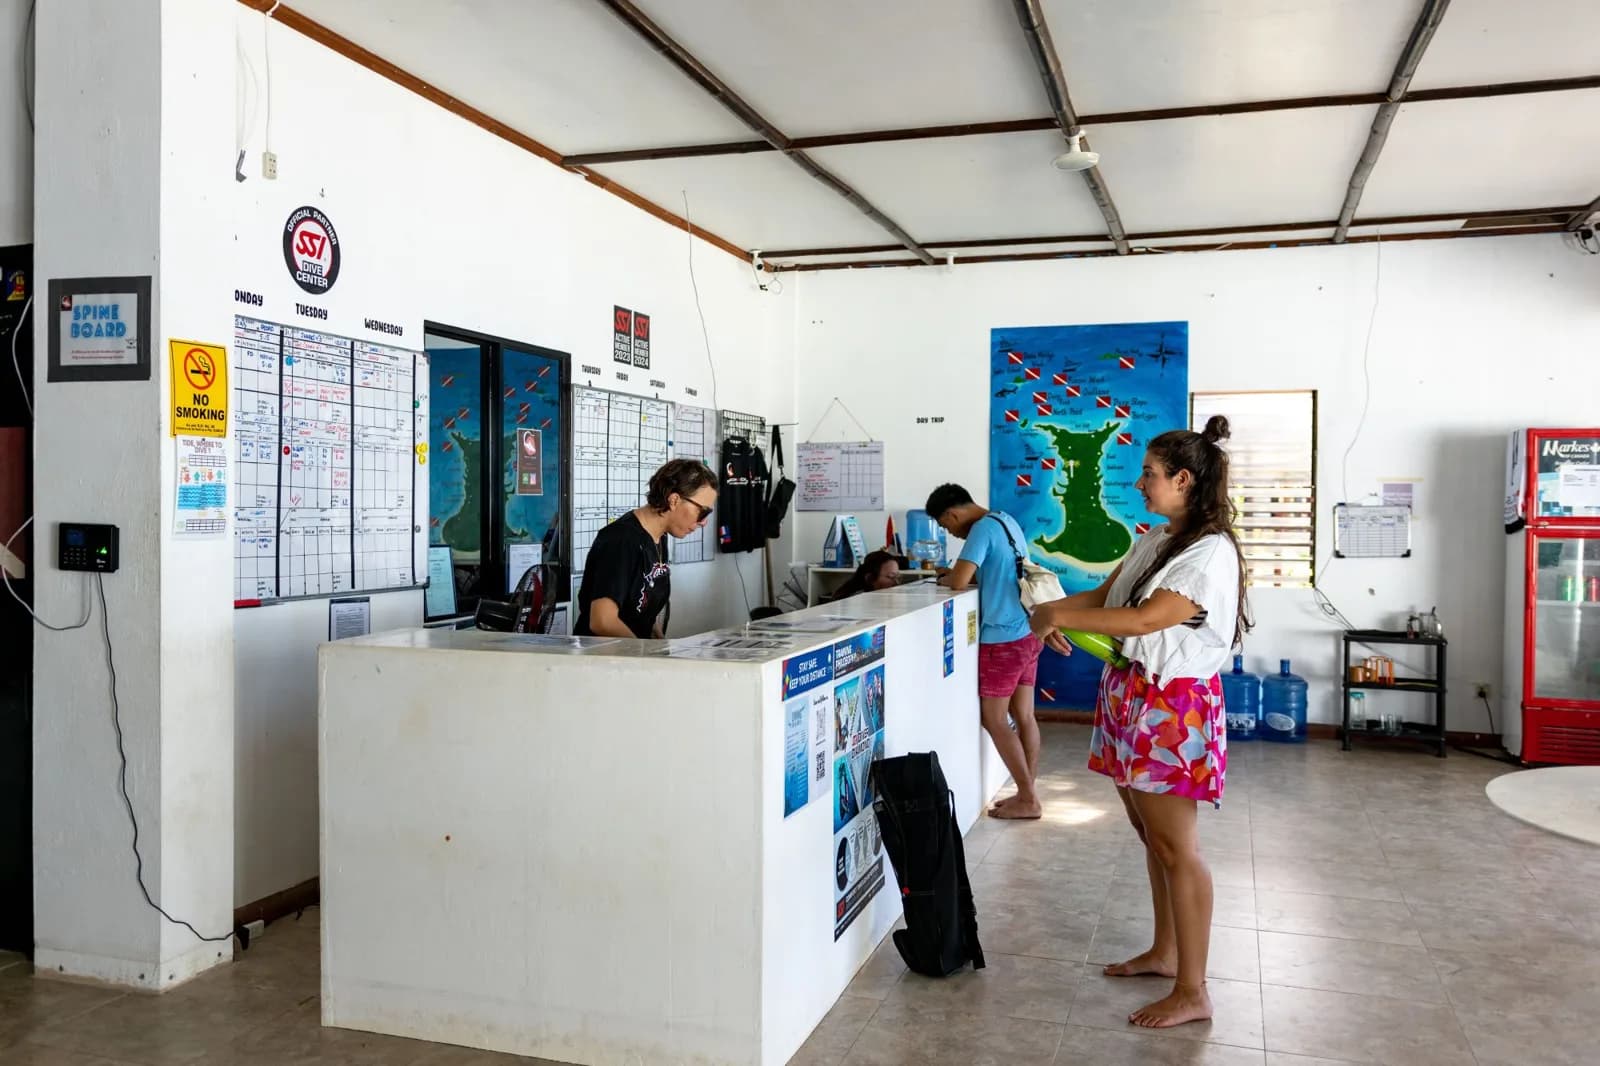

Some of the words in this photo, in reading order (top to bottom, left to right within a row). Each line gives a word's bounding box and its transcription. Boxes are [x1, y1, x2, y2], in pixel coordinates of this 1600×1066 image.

[287, 209, 311, 232] OFFICIAL
[313, 211, 337, 246] PARTNER
[295, 230, 326, 260] SSI
[302, 261, 323, 276] DIVE
[296, 270, 328, 289] CENTER
[234, 289, 263, 307] ONDAY
[73, 304, 120, 320] SPINE
[295, 303, 328, 320] TUESDAY
[364, 318, 403, 336] WEDNESDAY
[614, 310, 631, 333] SSI
[634, 316, 649, 339] SSI
[71, 322, 126, 338] BOARD
[614, 333, 631, 344] ACTIVE
[634, 339, 649, 350] ACTIVE
[614, 350, 631, 362] 2023
[634, 356, 649, 367] 2024
[193, 394, 209, 406] NO
[176, 407, 225, 421] SMOKING
[1542, 440, 1590, 458] Markes
[835, 645, 852, 660] TRAINING
[798, 659, 808, 673] STAY
[808, 658, 817, 669] SAFE
[789, 678, 799, 690] KEEP
[799, 674, 809, 686] YOUR
[809, 667, 827, 683] DISTANCE
